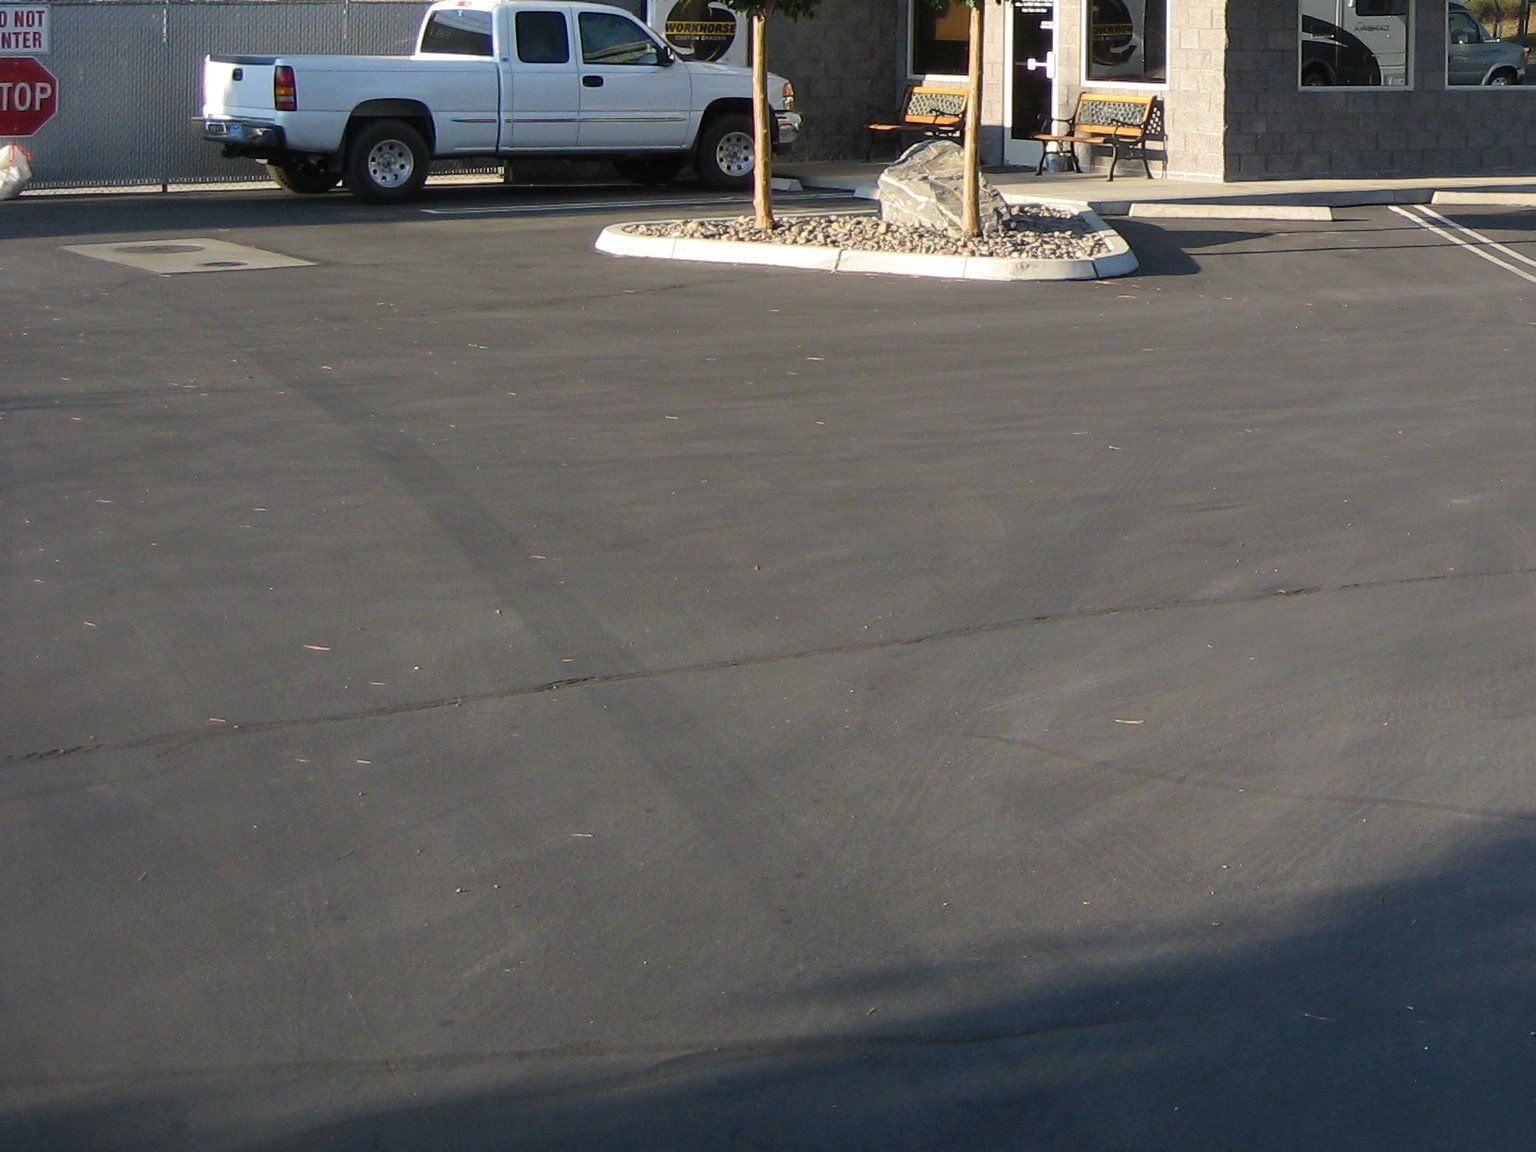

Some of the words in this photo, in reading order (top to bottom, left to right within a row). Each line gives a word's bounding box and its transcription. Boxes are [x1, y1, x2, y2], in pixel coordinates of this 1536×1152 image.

[0, 11, 7, 27] O
[15, 11, 45, 27] NOT
[666, 22, 736, 34] WORKHORSE
[0, 32, 42, 48] NTER
[0, 82, 52, 111] TOP
